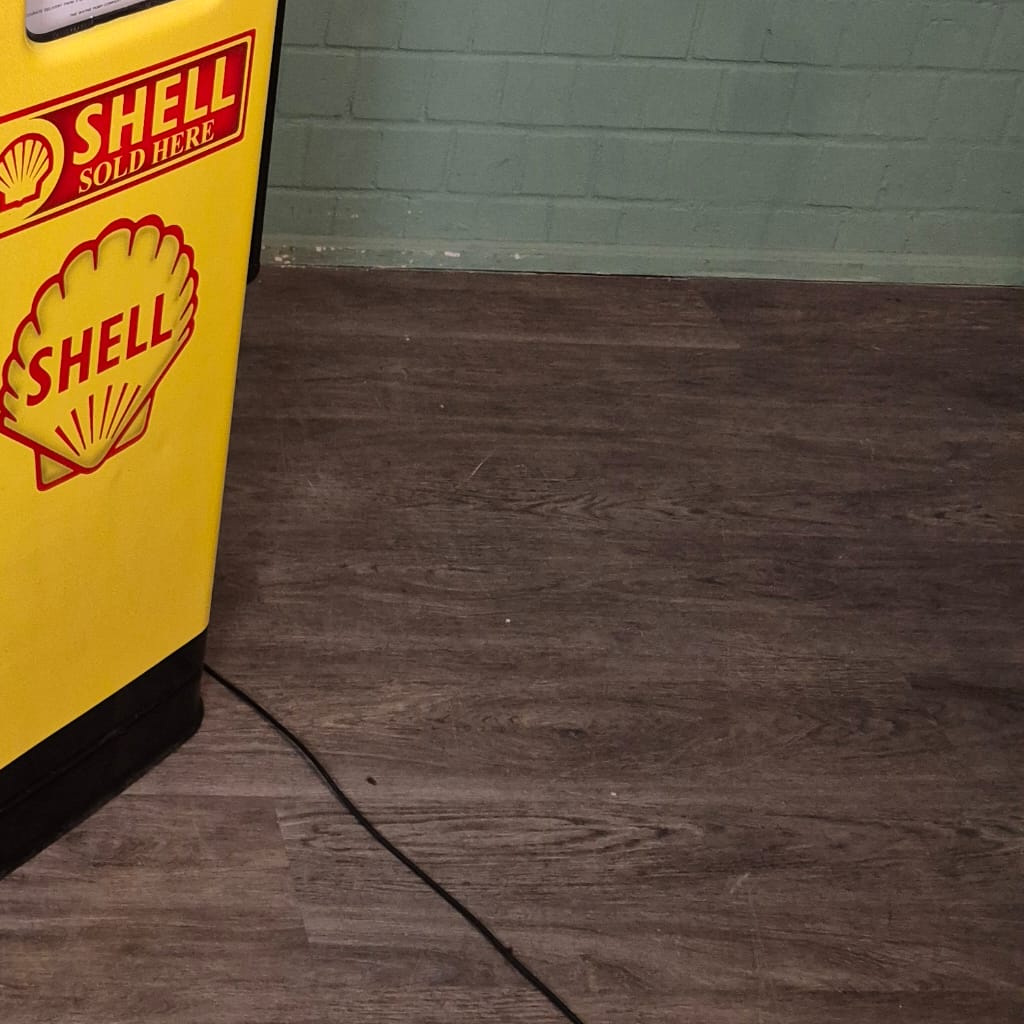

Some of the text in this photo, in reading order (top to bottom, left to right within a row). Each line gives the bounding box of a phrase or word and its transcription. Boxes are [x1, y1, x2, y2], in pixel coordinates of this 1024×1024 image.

[72, 56, 236, 166] SHELL
[78, 119, 216, 194] SOLD HERE
[26, 294, 172, 407] SHELL
